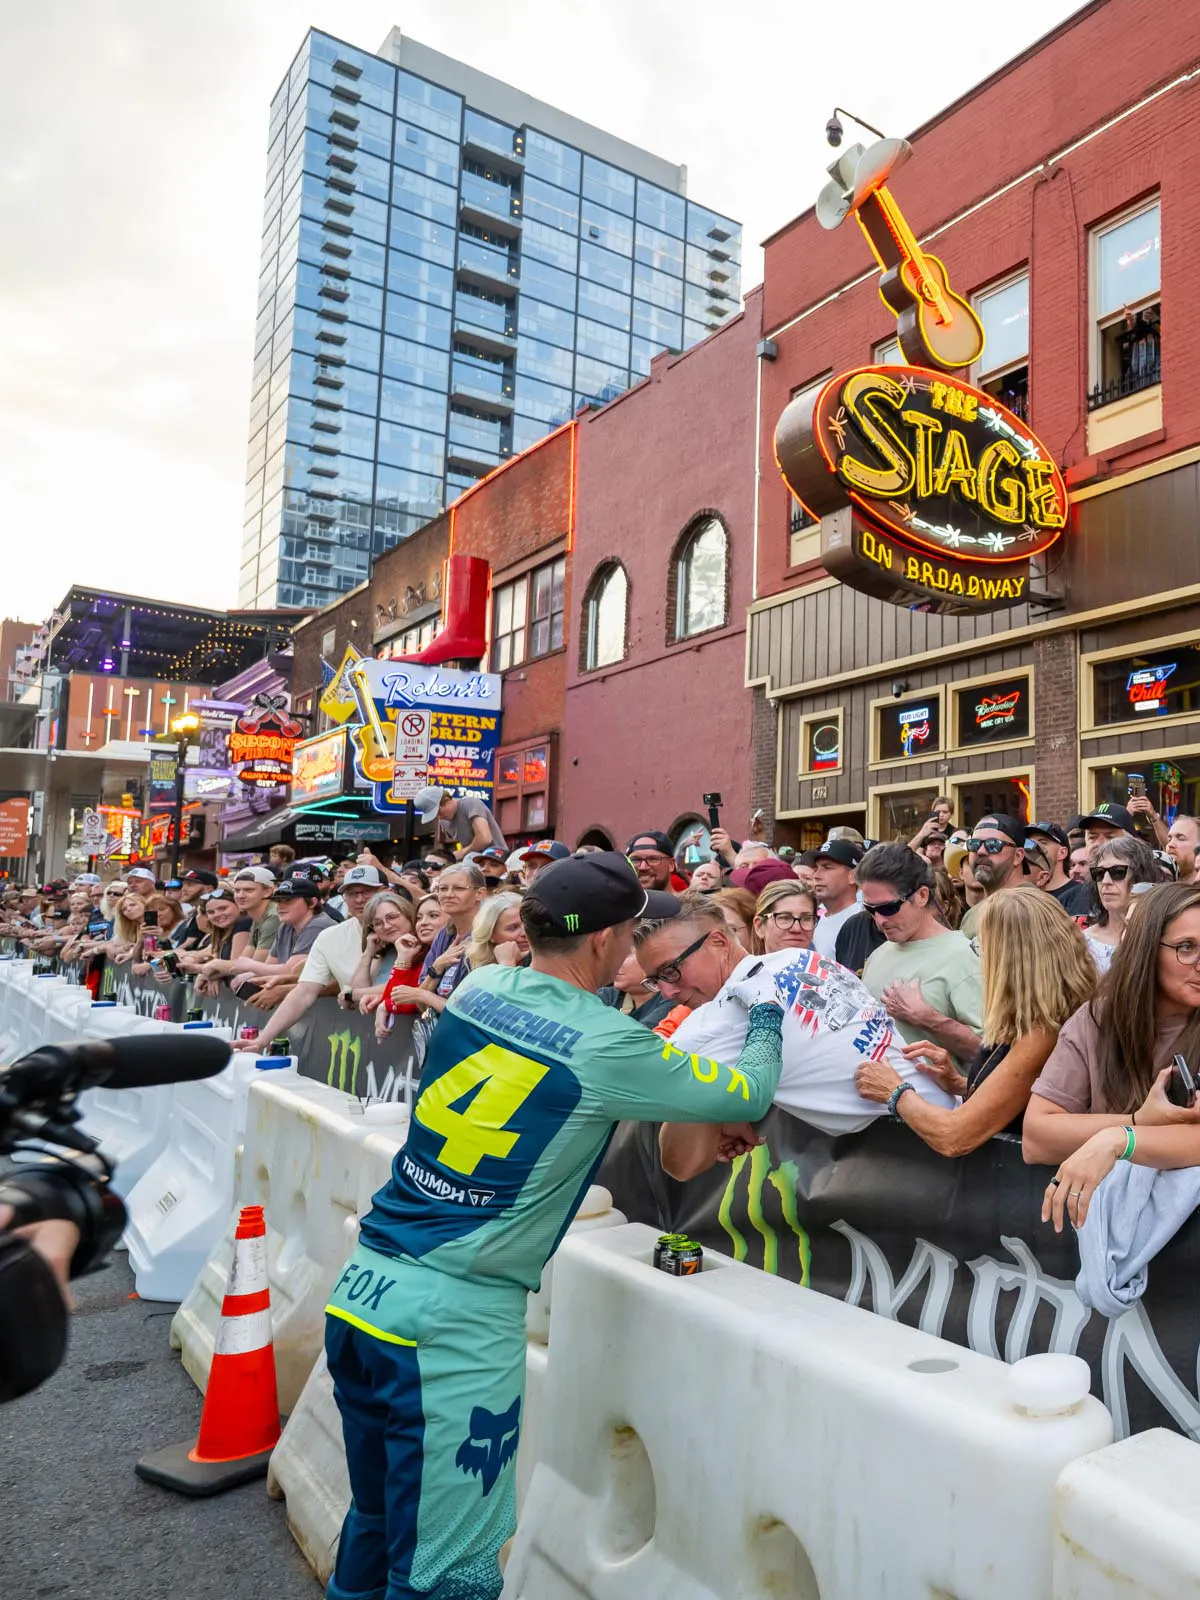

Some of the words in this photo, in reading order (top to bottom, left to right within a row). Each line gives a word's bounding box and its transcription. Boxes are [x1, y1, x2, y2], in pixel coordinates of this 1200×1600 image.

[931, 381, 978, 422] THE
[840, 372, 1065, 528] STAGE
[862, 531, 893, 569] ON
[906, 557, 1025, 601] BROADWAY
[382, 672, 495, 707] Robert's
[1129, 680, 1168, 702] Chill
[901, 712, 912, 721] BUD
[912, 710, 927, 719] LIGHT
[254, 763, 281, 773] MUSIC
[429, 743, 480, 760] OME
[256, 780, 278, 788] CITY
[415, 1042, 551, 1176] 4
[402, 1155, 465, 1204] TRIUMPH
[333, 1263, 397, 1311] FOX
